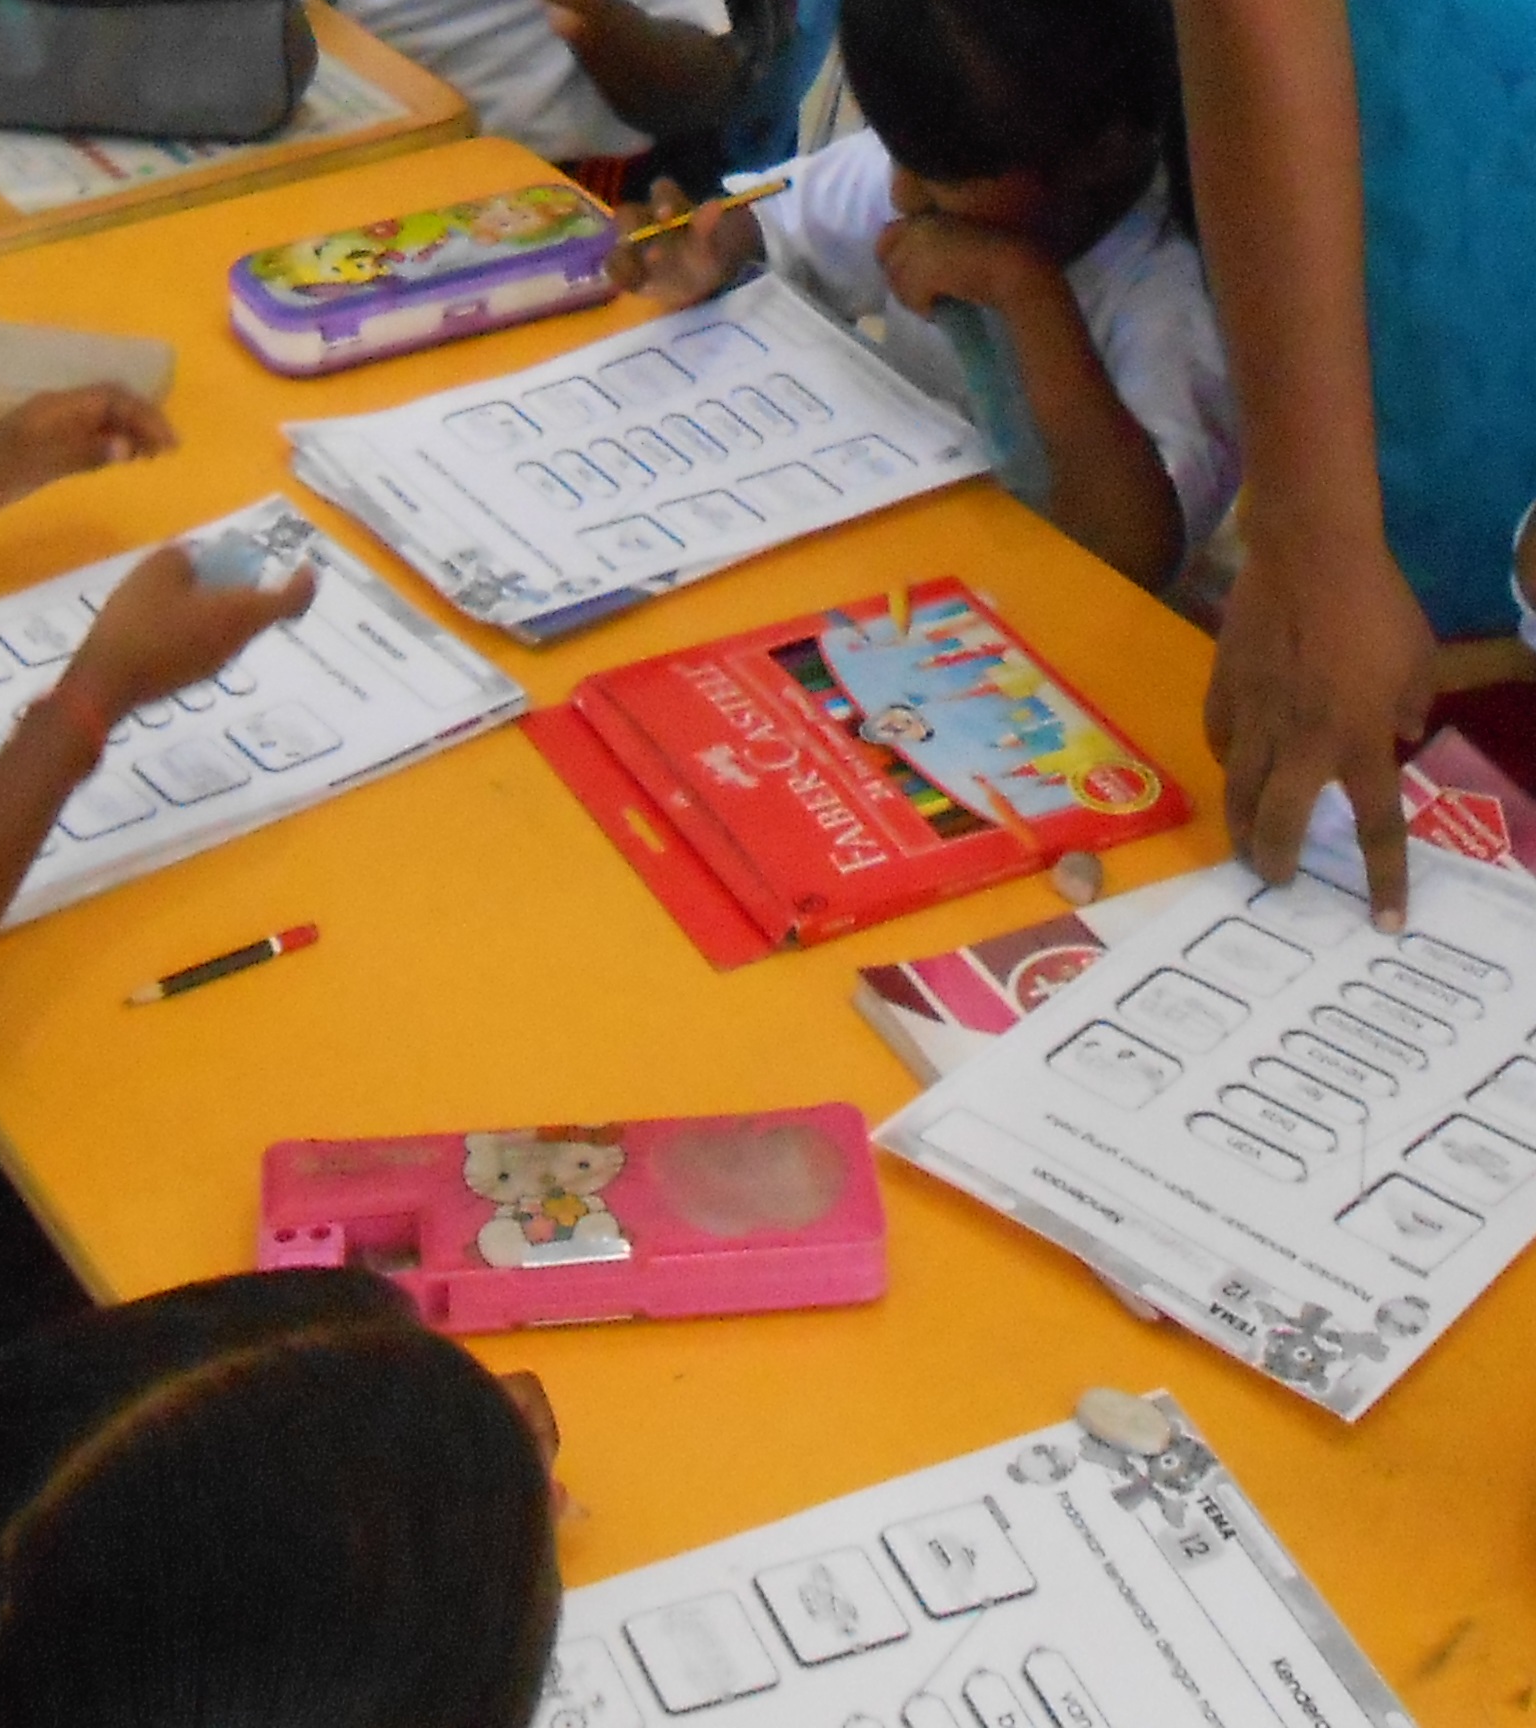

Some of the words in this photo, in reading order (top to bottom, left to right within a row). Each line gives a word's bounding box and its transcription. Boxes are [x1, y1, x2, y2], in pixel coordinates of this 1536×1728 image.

[1030, 1165, 1126, 1226] Kenderaan
[1220, 1280, 1251, 1302] 12
[1208, 1302, 1260, 1338] TEMA
[1196, 1495, 1238, 1541] TEMA
[1178, 1533, 1211, 1559] 12
[1058, 1490, 1107, 1558] Padankan
[1104, 1560, 1159, 1635] kenderaan
[1154, 1638, 1202, 1695] dengan
